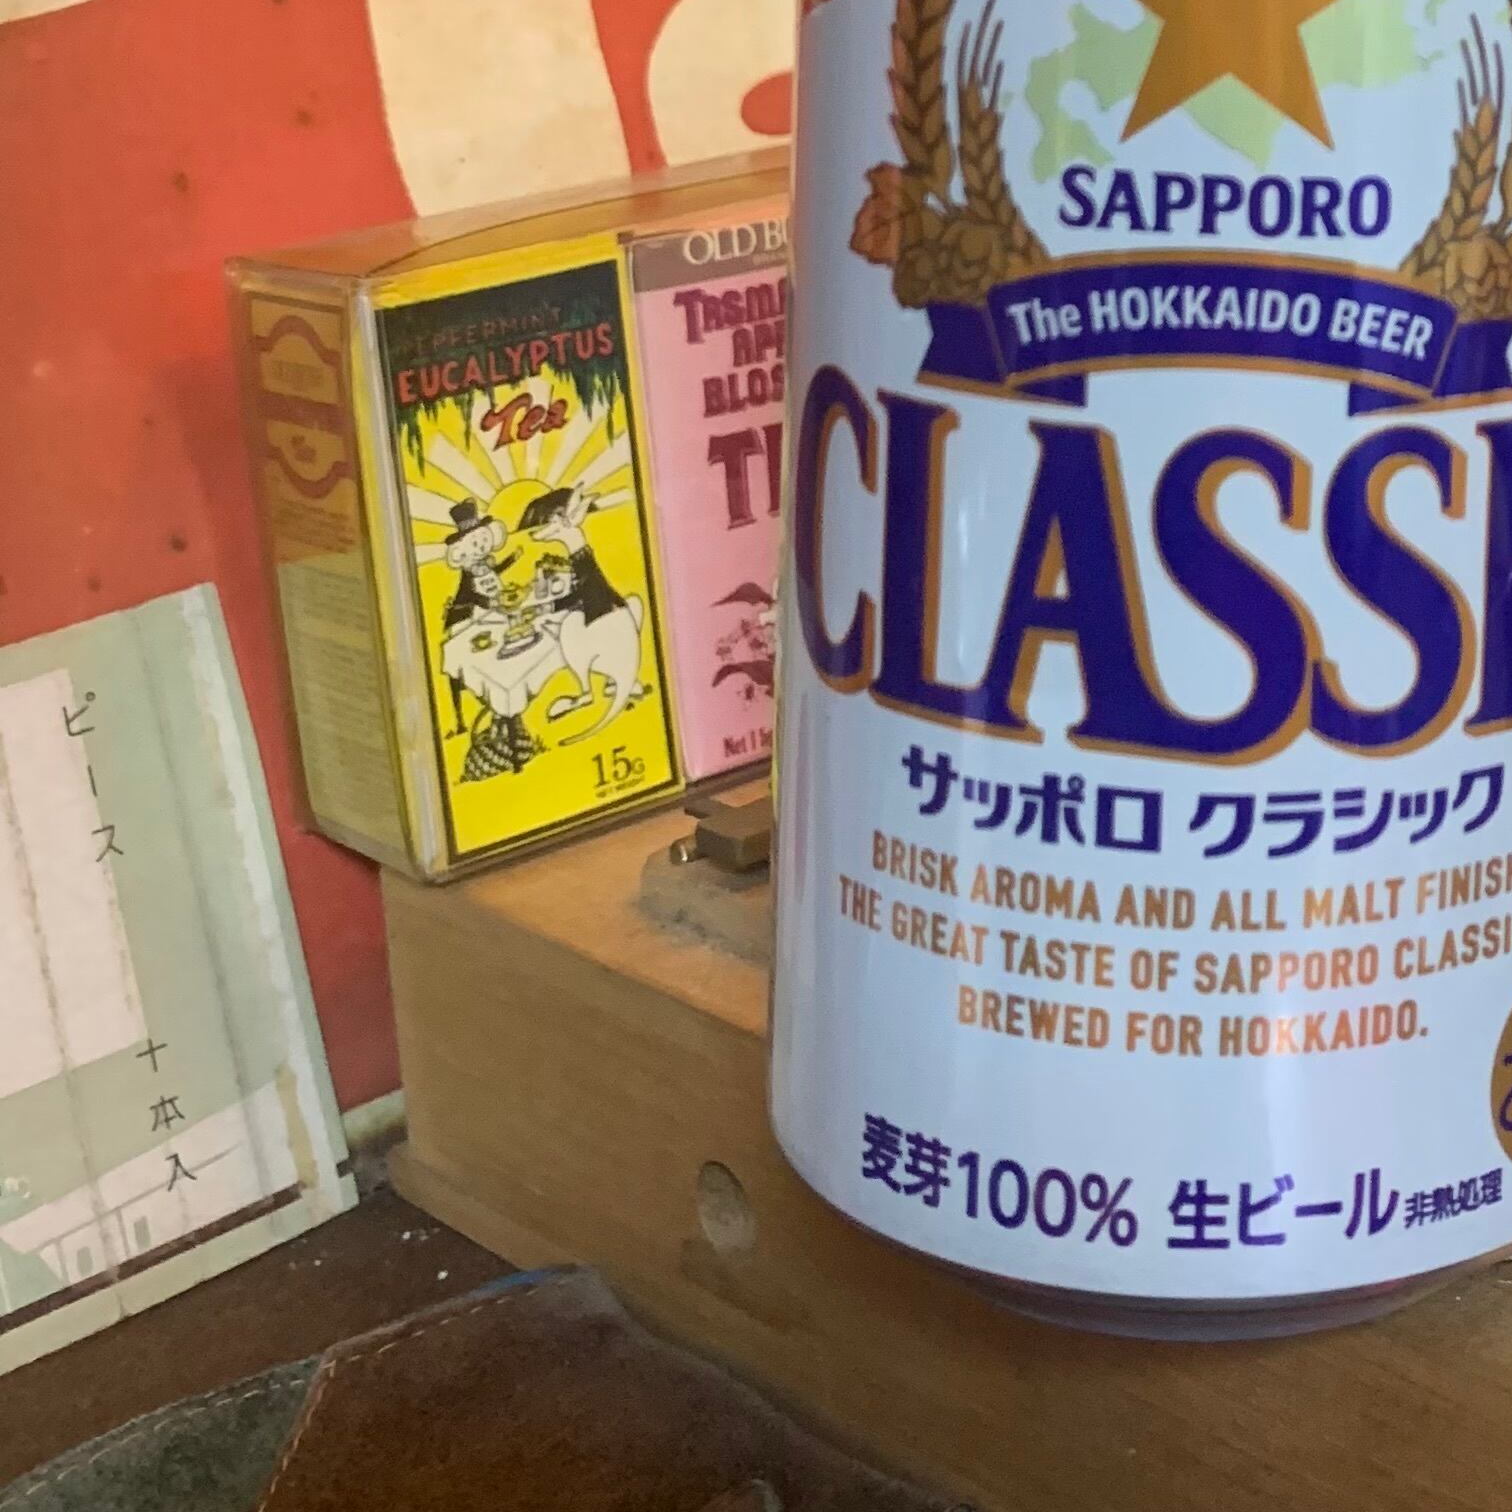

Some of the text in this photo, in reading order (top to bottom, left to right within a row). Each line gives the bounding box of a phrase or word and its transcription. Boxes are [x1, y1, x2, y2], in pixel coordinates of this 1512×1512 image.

[1059, 163, 1393, 239] SAPPORO
[683, 223, 757, 265] OLD
[1007, 284, 1434, 360] The HOKKAIDO BEER
[396, 322, 614, 405] EUCALYPTUS
[480, 391, 568, 452] Tea
[63, 691, 124, 863] ピース
[872, 828, 958, 896] BRISK
[970, 863, 1101, 924] AROMA
[1115, 884, 1196, 931] AND
[1210, 890, 1286, 932] ALL
[1303, 877, 1405, 928] MALT
[839, 874, 882, 932] THE
[891, 901, 989, 967] GREAT
[1000, 929, 1116, 988] TASTE
[1130, 948, 1180, 992] OF
[1194, 943, 1380, 995] SAPPORO
[958, 984, 1430, 1057] BREWED FOR HOKKAIDO.
[136, 1037, 198, 1192] 十本入
[1167, 1168, 1399, 1250] 生ビール
